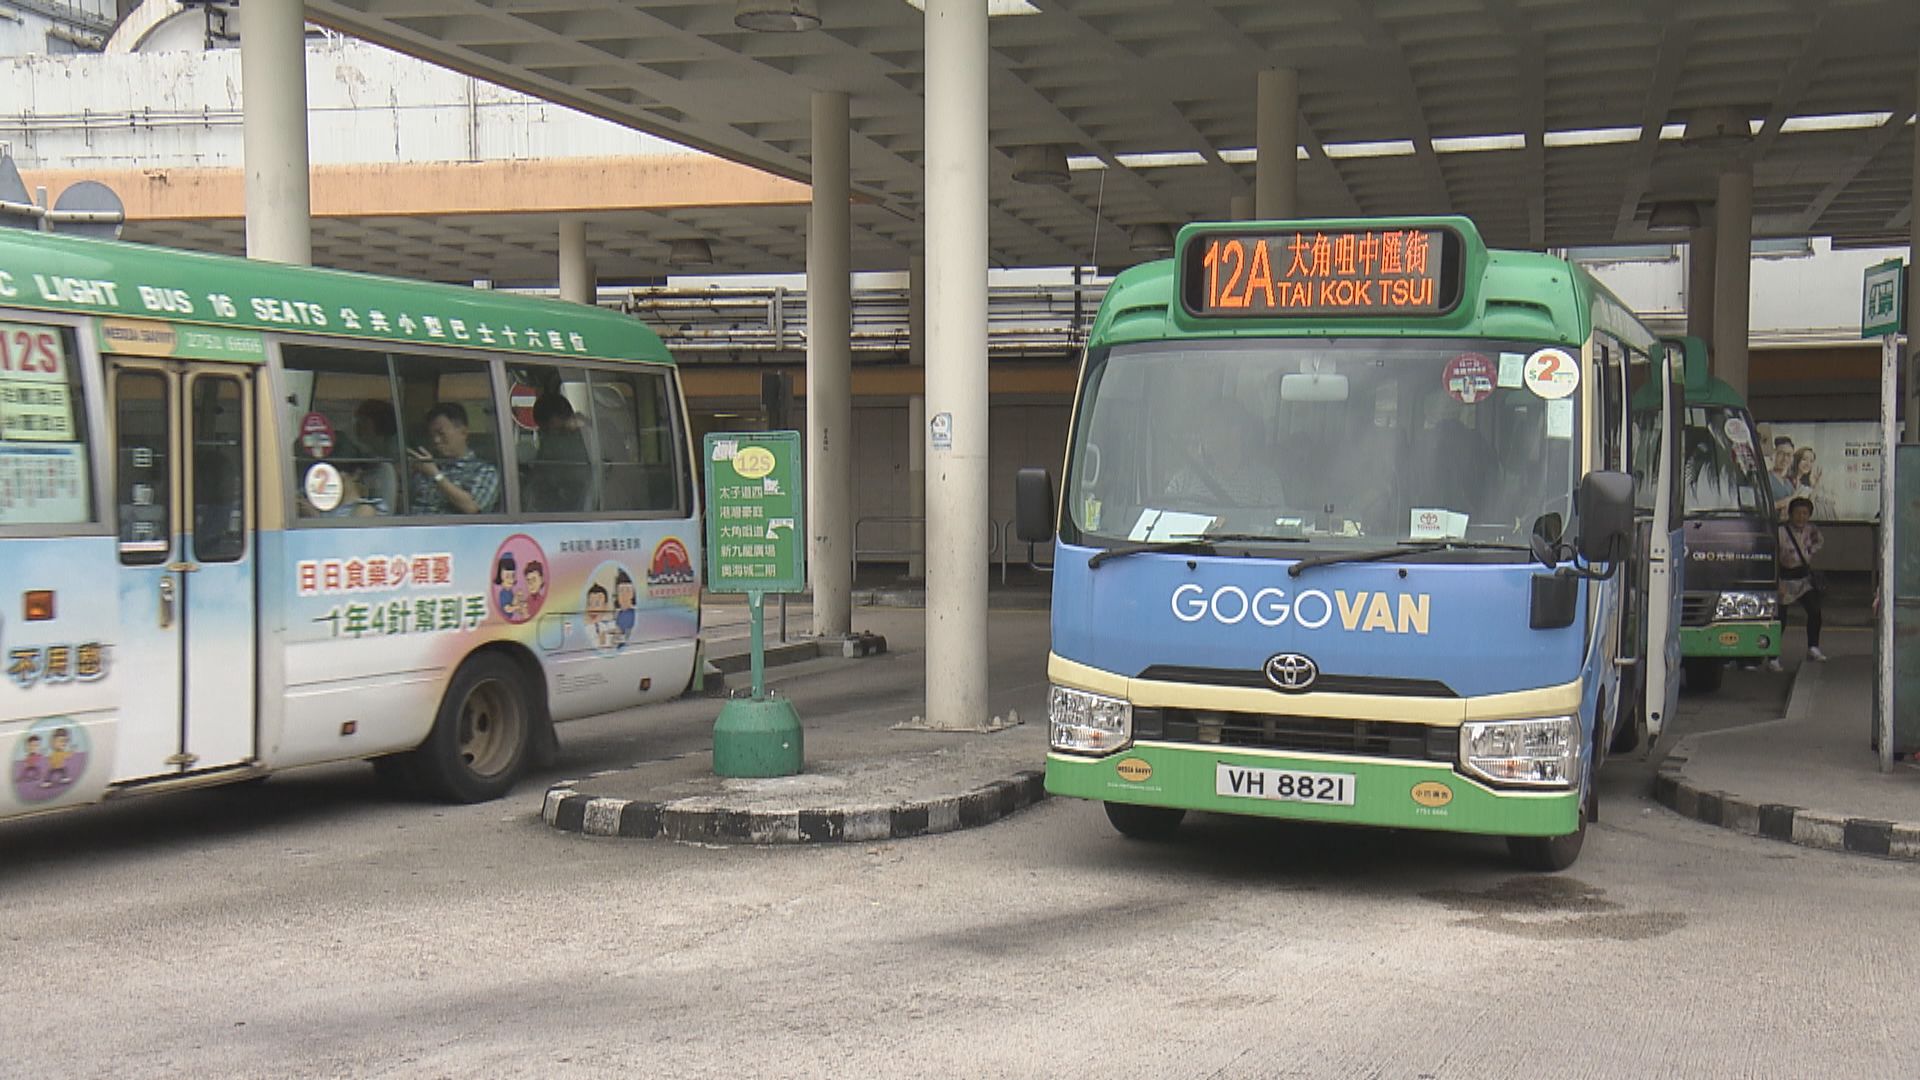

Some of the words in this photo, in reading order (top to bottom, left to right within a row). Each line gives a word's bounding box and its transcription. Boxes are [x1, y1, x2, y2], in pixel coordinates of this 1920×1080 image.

[1204, 239, 1275, 307] 12A
[1286, 230, 1428, 278] 大角咀中匯街
[32, 274, 119, 306] LIGHT
[138, 286, 194, 313] BUS
[207, 294, 237, 318] 16
[251, 298, 327, 326] SEATS
[1278, 280, 1313, 307] TAI
[1320, 280, 1372, 306] KOK
[1379, 278, 1433, 305] TSUI
[0, 330, 57, 373] 12S
[738, 454, 771, 472] 12S
[302, 556, 451, 591] 日日食藥少煩憂
[1171, 583, 1430, 634] GOGOVAN
[1229, 770, 1264, 795] VH
[1277, 774, 1343, 801] 8821
